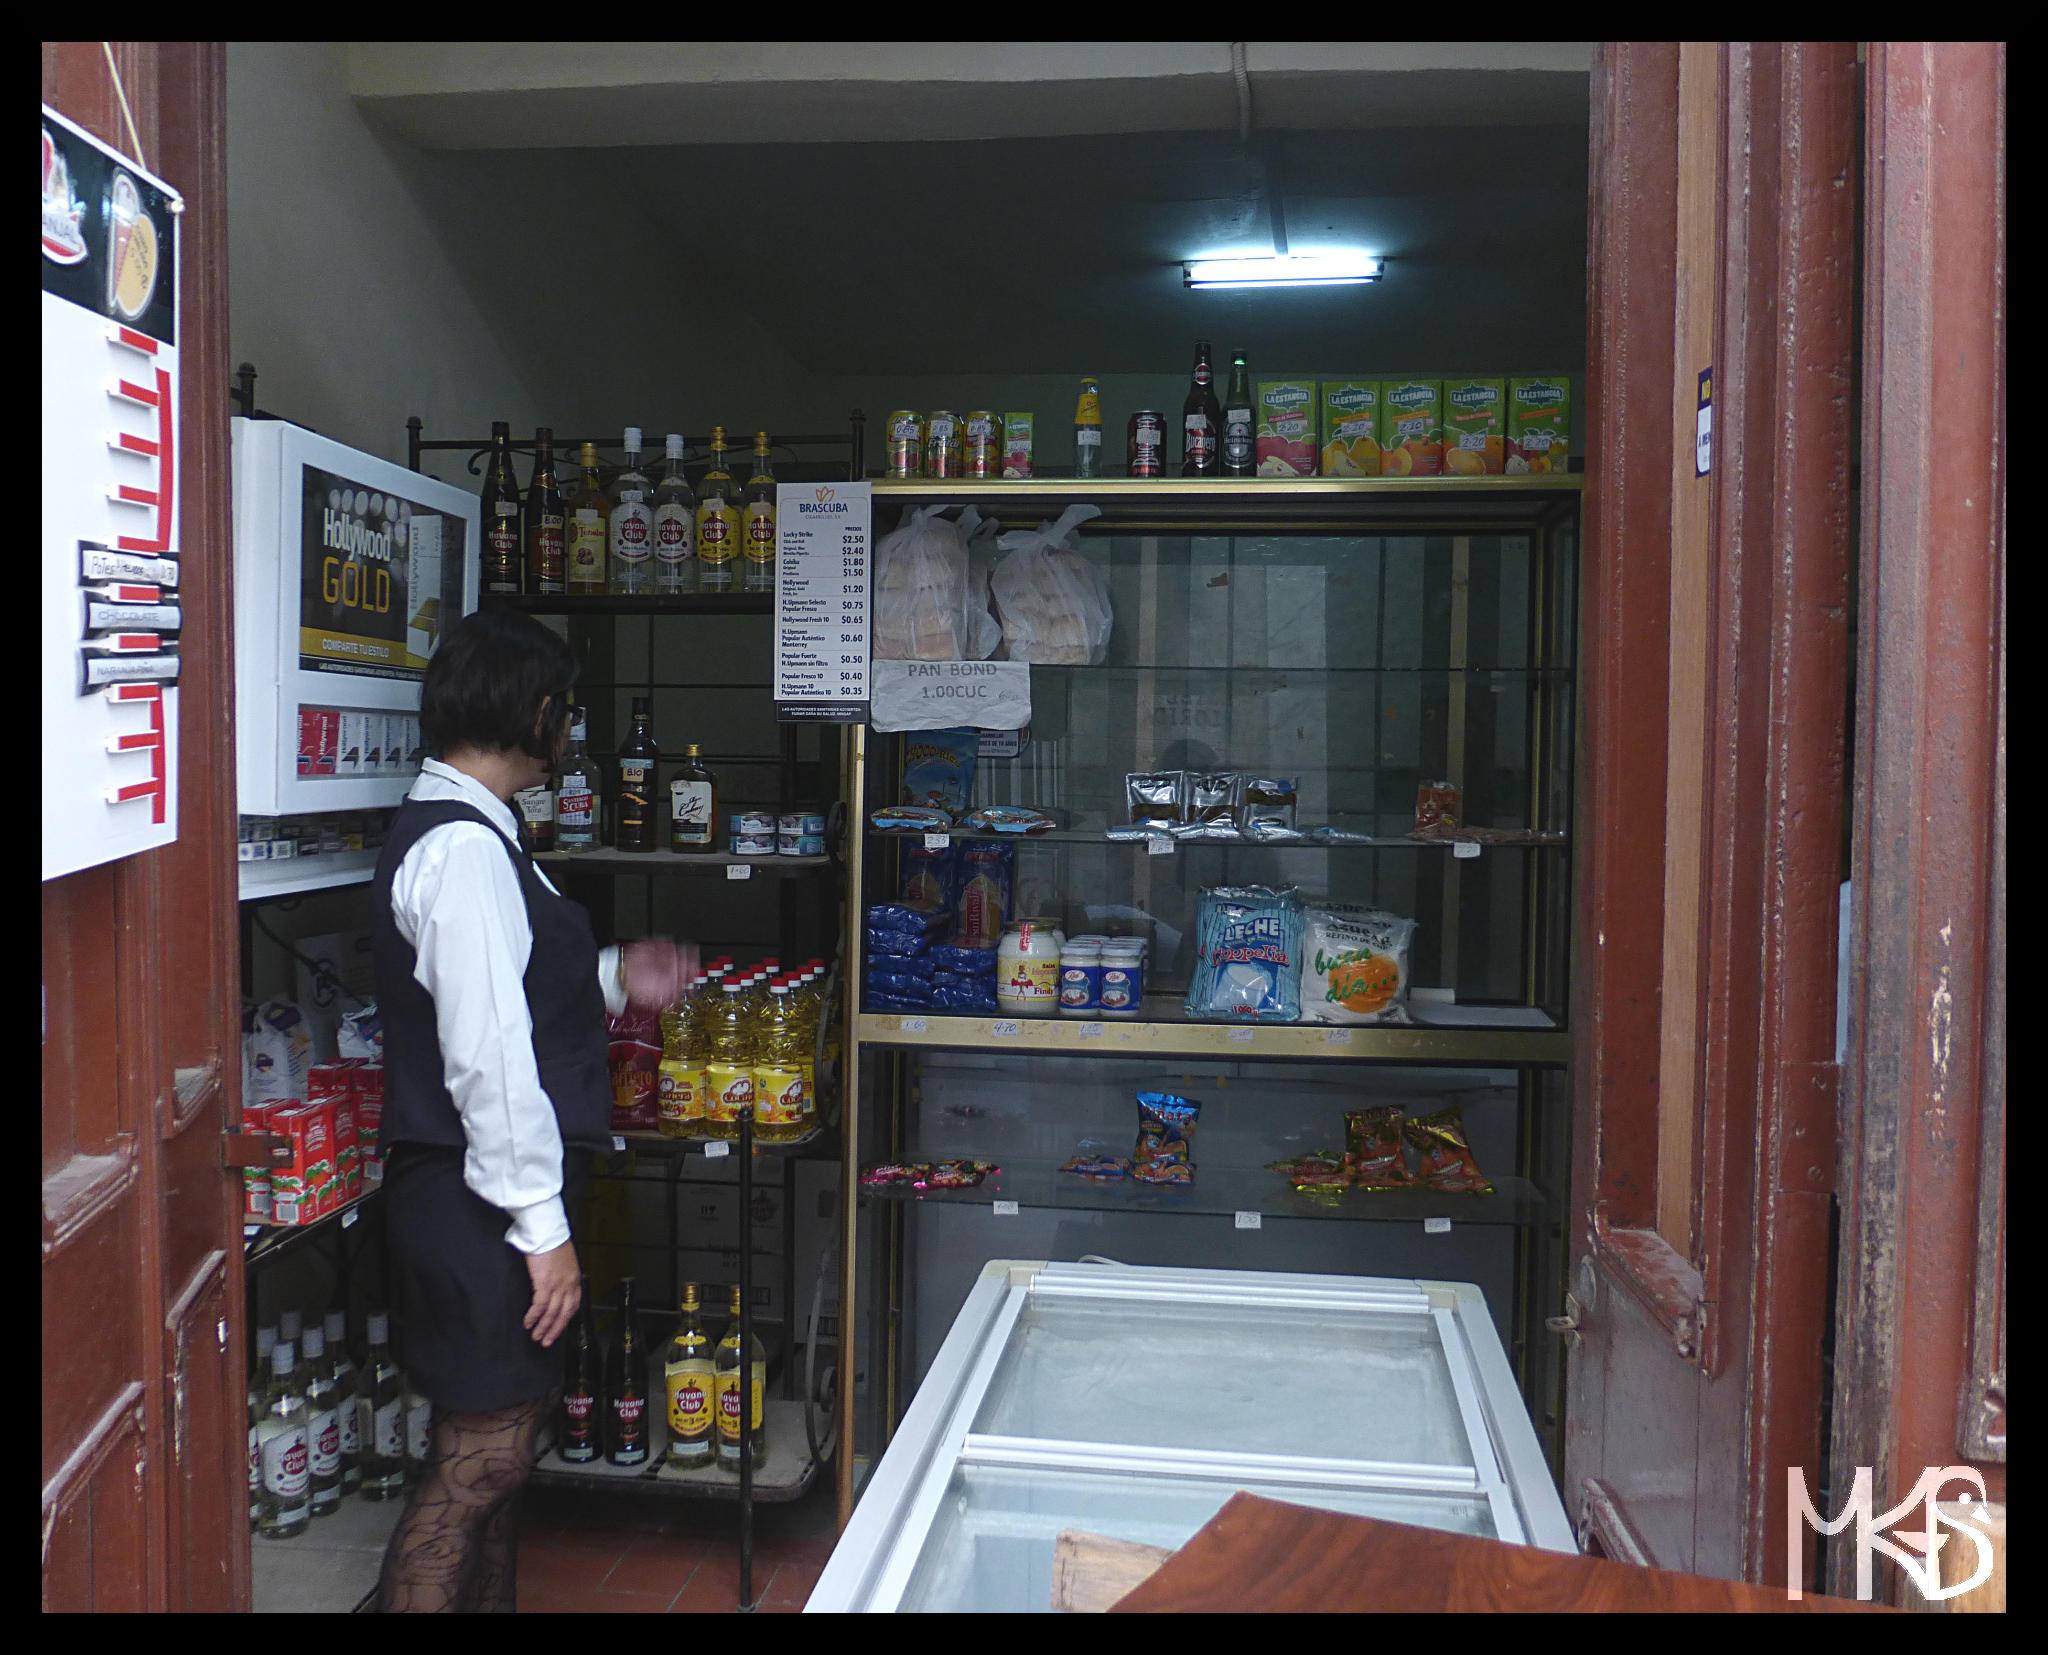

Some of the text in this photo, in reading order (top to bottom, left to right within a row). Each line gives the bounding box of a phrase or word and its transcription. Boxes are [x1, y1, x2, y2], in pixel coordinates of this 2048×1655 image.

[1266, 391, 1308, 403] LA ESTANCIA
[1331, 392, 1374, 404] LA ESTANCIA
[1390, 390, 1433, 402] LA ESTANCIA
[1453, 390, 1495, 401] LA ESTANCIA
[1518, 388, 1561, 399] LA ESTANCIA
[1185, 434, 1216, 451] Bucanero
[799, 503, 849, 513] BRASCUBA
[324, 507, 391, 562] Hollywood
[624, 531, 643, 539] Club
[661, 532, 681, 541] Club
[704, 530, 724, 539] Club
[752, 530, 771, 539] Club
[783, 531, 797, 539] Lucky
[842, 535, 864, 544] $2.50
[494, 540, 513, 549] Club
[842, 547, 864, 556] $2.40
[843, 557, 864, 567] $1.80
[843, 568, 863, 577] $1.50
[323, 556, 390, 614] GOLD
[782, 579, 809, 587] Hollywood
[843, 585, 863, 594] $1.20
[842, 601, 863, 610] $0.75
[782, 616, 809, 624] Hollywood
[841, 615, 863, 624] $0.65
[840, 634, 863, 643] $0.60
[840, 655, 863, 664] $0.50
[908, 663, 997, 677] PAN BOND
[840, 672, 863, 681] $0.40
[782, 689, 800, 697] Popular
[840, 686, 862, 696] $0.35
[921, 685, 987, 699] 1.00CUC
[319, 716, 329, 755] Hollywood
[1225, 918, 1280, 942] LECHE
[1326, 931, 1358, 942] REFINO
[1212, 945, 1290, 967] Coppelia
[673, 1390, 708, 1400] Havana
[718, 1391, 740, 1402] Hava
[613, 1398, 645, 1409] Havana
[680, 1400, 701, 1410] Club
[568, 1404, 587, 1414] Club
[619, 1407, 639, 1417] Club
